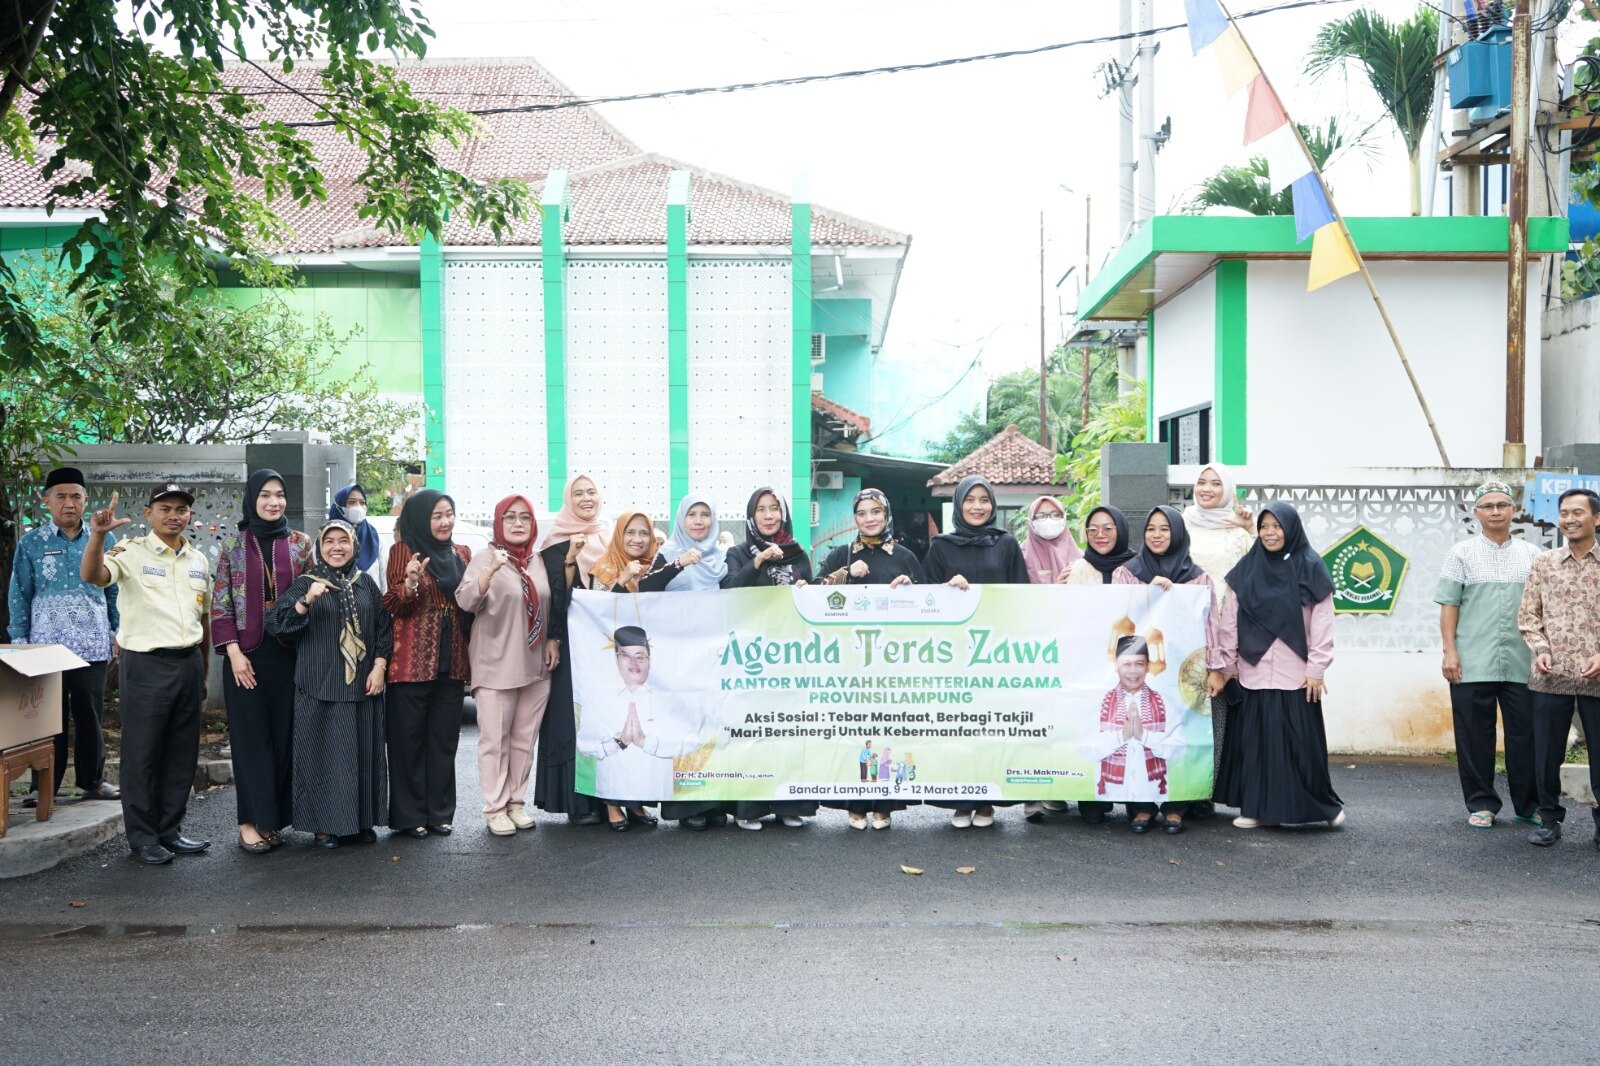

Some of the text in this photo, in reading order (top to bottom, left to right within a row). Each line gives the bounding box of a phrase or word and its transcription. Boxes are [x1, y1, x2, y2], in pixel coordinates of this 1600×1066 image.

[716, 629, 1060, 676] Agenda Teras Zawa
[721, 676, 1062, 690] KANTOR WILAYAH KEMENTERIAN AGAMA
[809, 691, 973, 704] PROVINSI LAMPUNG
[744, 711, 775, 723] Aksi
[777, 711, 818, 722] Sosial
[828, 712, 868, 722] Tebar
[871, 712, 934, 724] Manfaat,
[936, 711, 991, 725] Berbagi
[994, 711, 1033, 725] Takjil
[765, 725, 836, 740] Bersinergi
[838, 726, 881, 736] Untuk
[884, 726, 1005, 737] Kebermanfaatan
[698, 771, 745, 779] Zulkarnain,
[789, 785, 832, 794] Bandar
[833, 785, 892, 796] Lampung,
[894, 785, 900, 794] 9
[911, 785, 922, 794] 12
[924, 785, 958, 794] Maret
[961, 785, 988, 794] 2026
